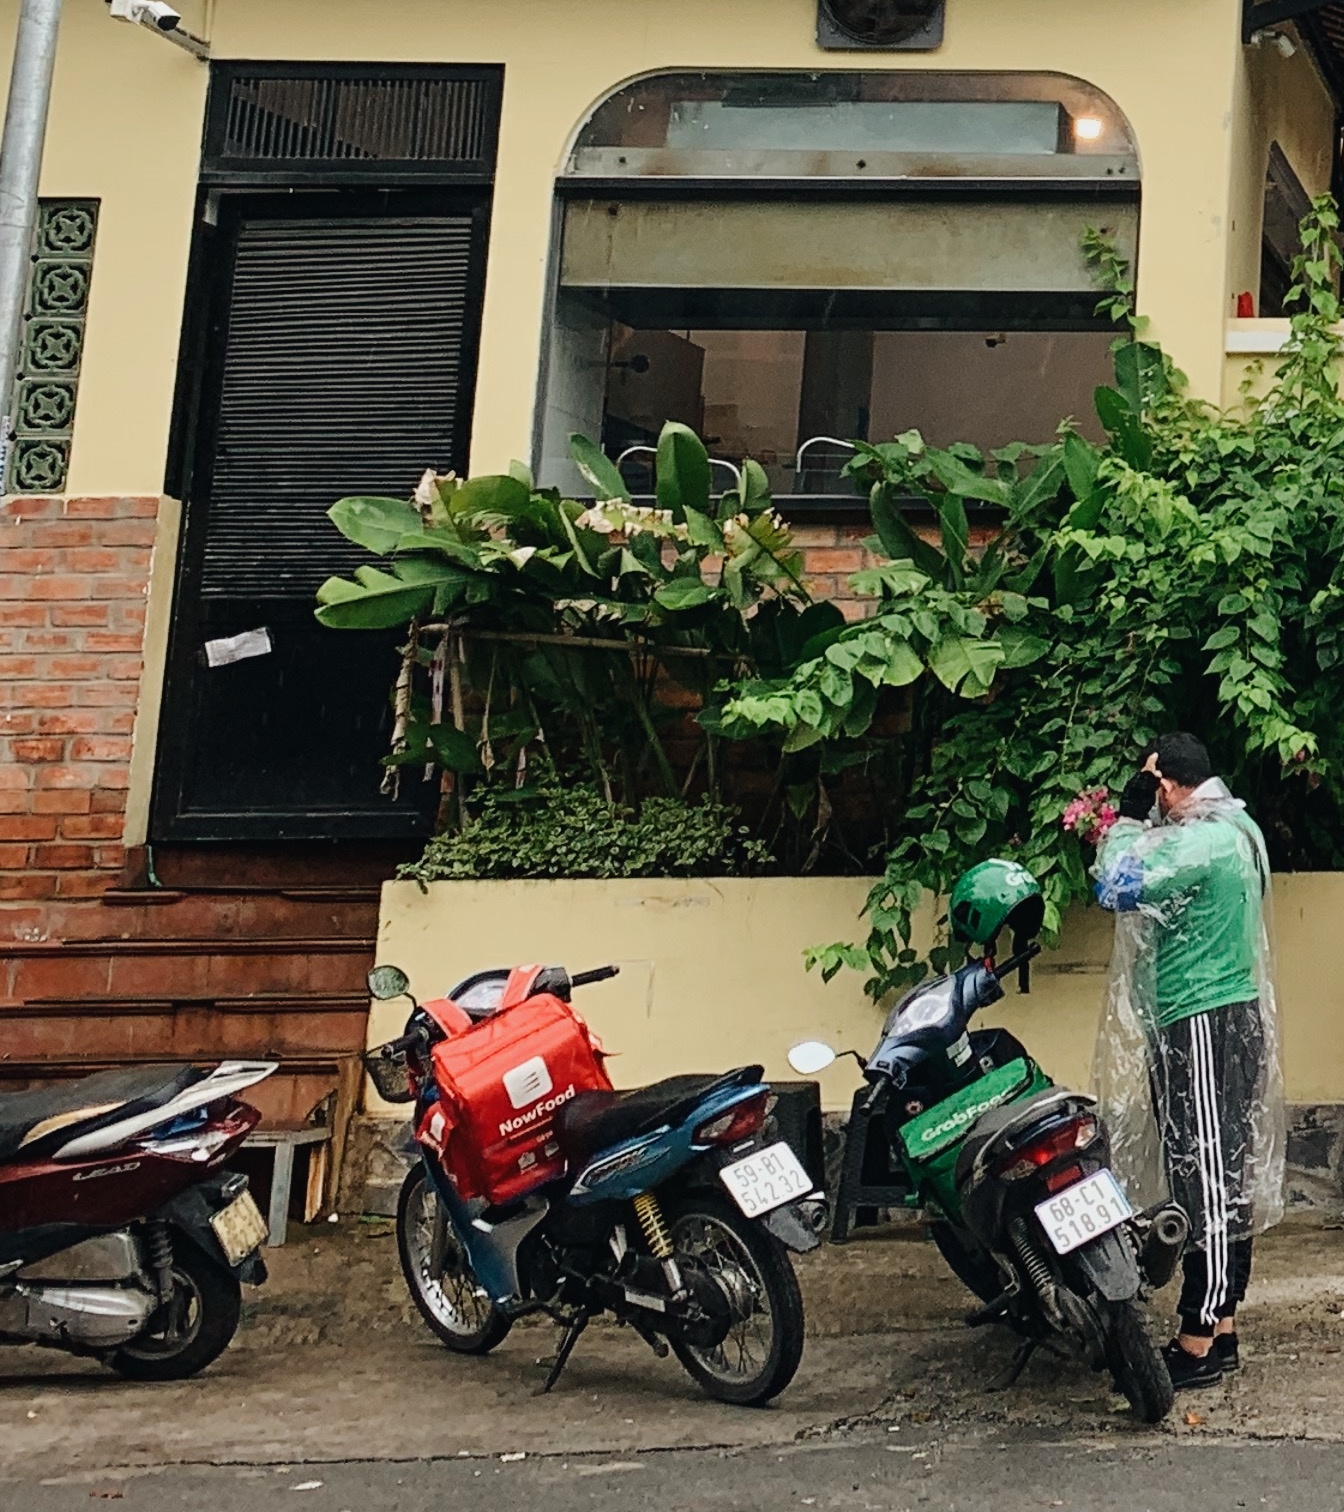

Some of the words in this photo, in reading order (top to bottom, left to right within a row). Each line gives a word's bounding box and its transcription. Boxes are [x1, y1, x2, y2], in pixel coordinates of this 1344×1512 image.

[499, 1083, 576, 1137] NowFood
[733, 1152, 785, 1188] 59-B1
[741, 1169, 806, 1211] 542.32
[1049, 1180, 1105, 1222] 68-C1
[1053, 1196, 1125, 1248] 518.91
